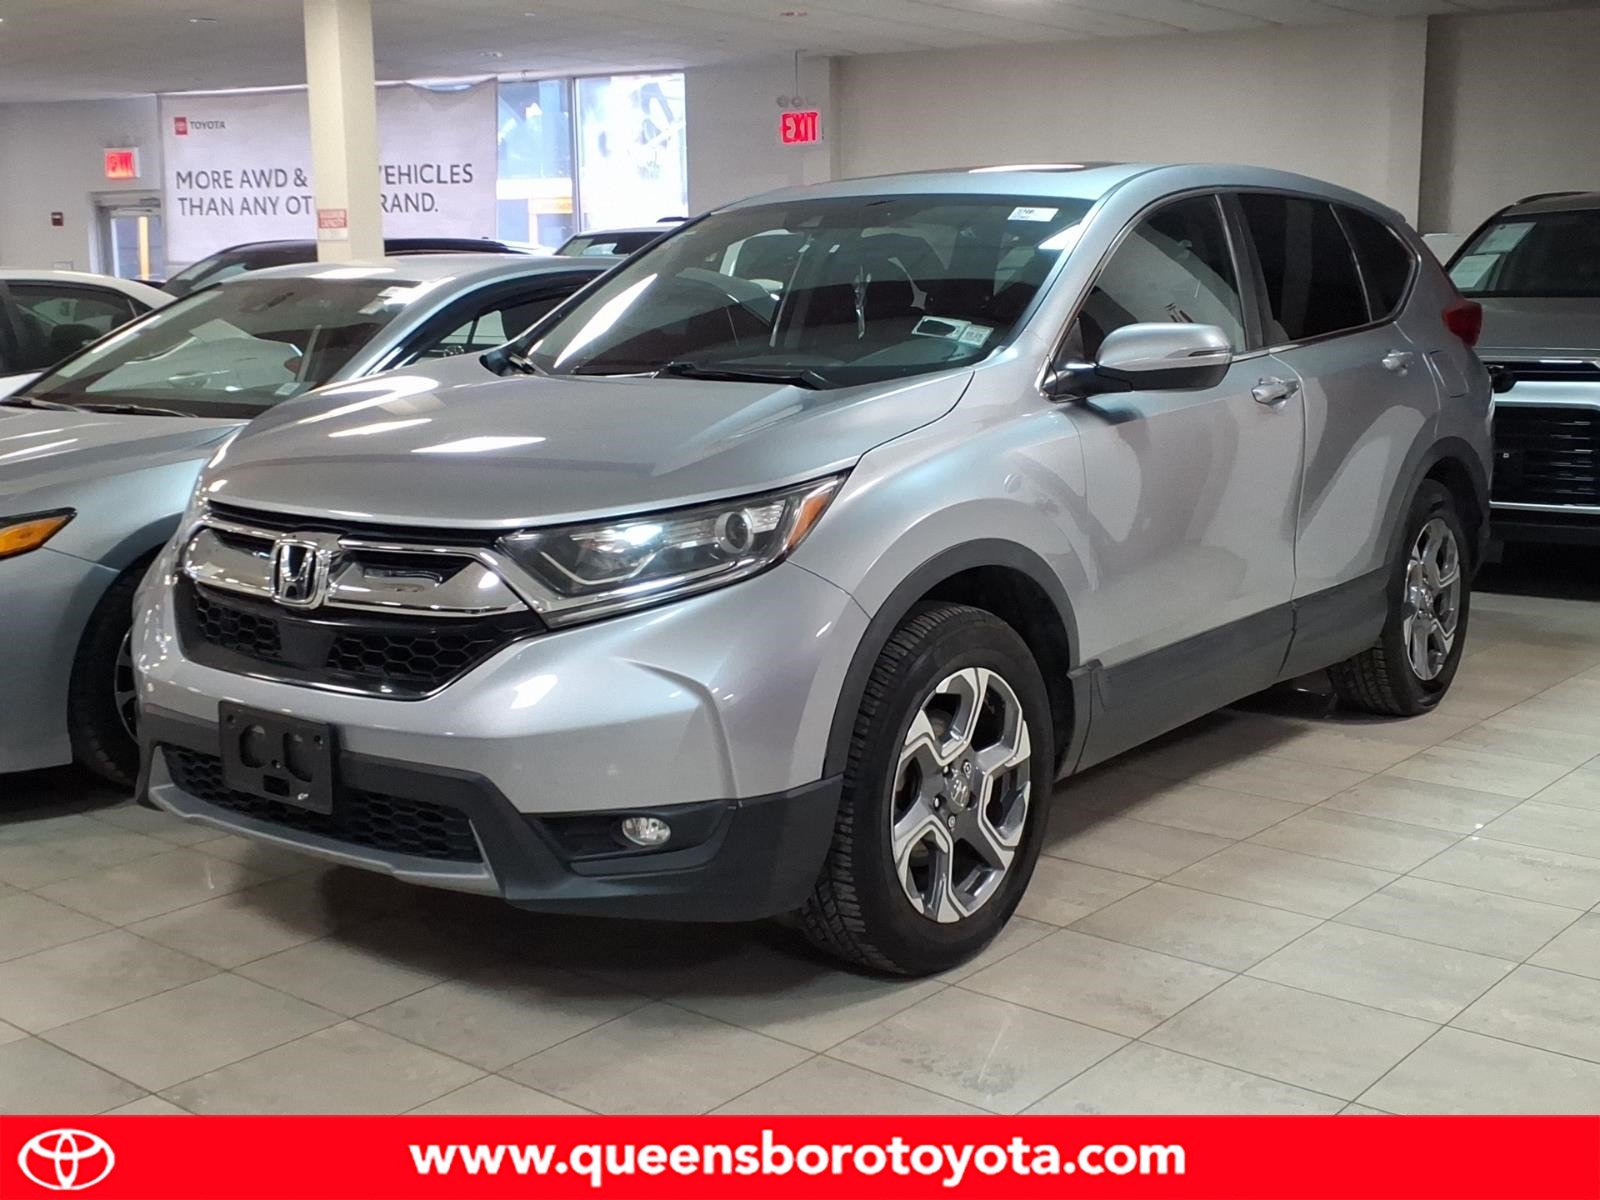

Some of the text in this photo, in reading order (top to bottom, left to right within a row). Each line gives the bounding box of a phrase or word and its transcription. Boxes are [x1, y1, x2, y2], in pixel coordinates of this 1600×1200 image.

[190, 120, 226, 130] TOYOTA
[782, 112, 818, 143] EXIT
[176, 162, 475, 190] MORE AWD & EHICLES
[177, 196, 235, 217] THAN
[239, 196, 280, 216] ANY
[380, 192, 439, 213] RAND.
